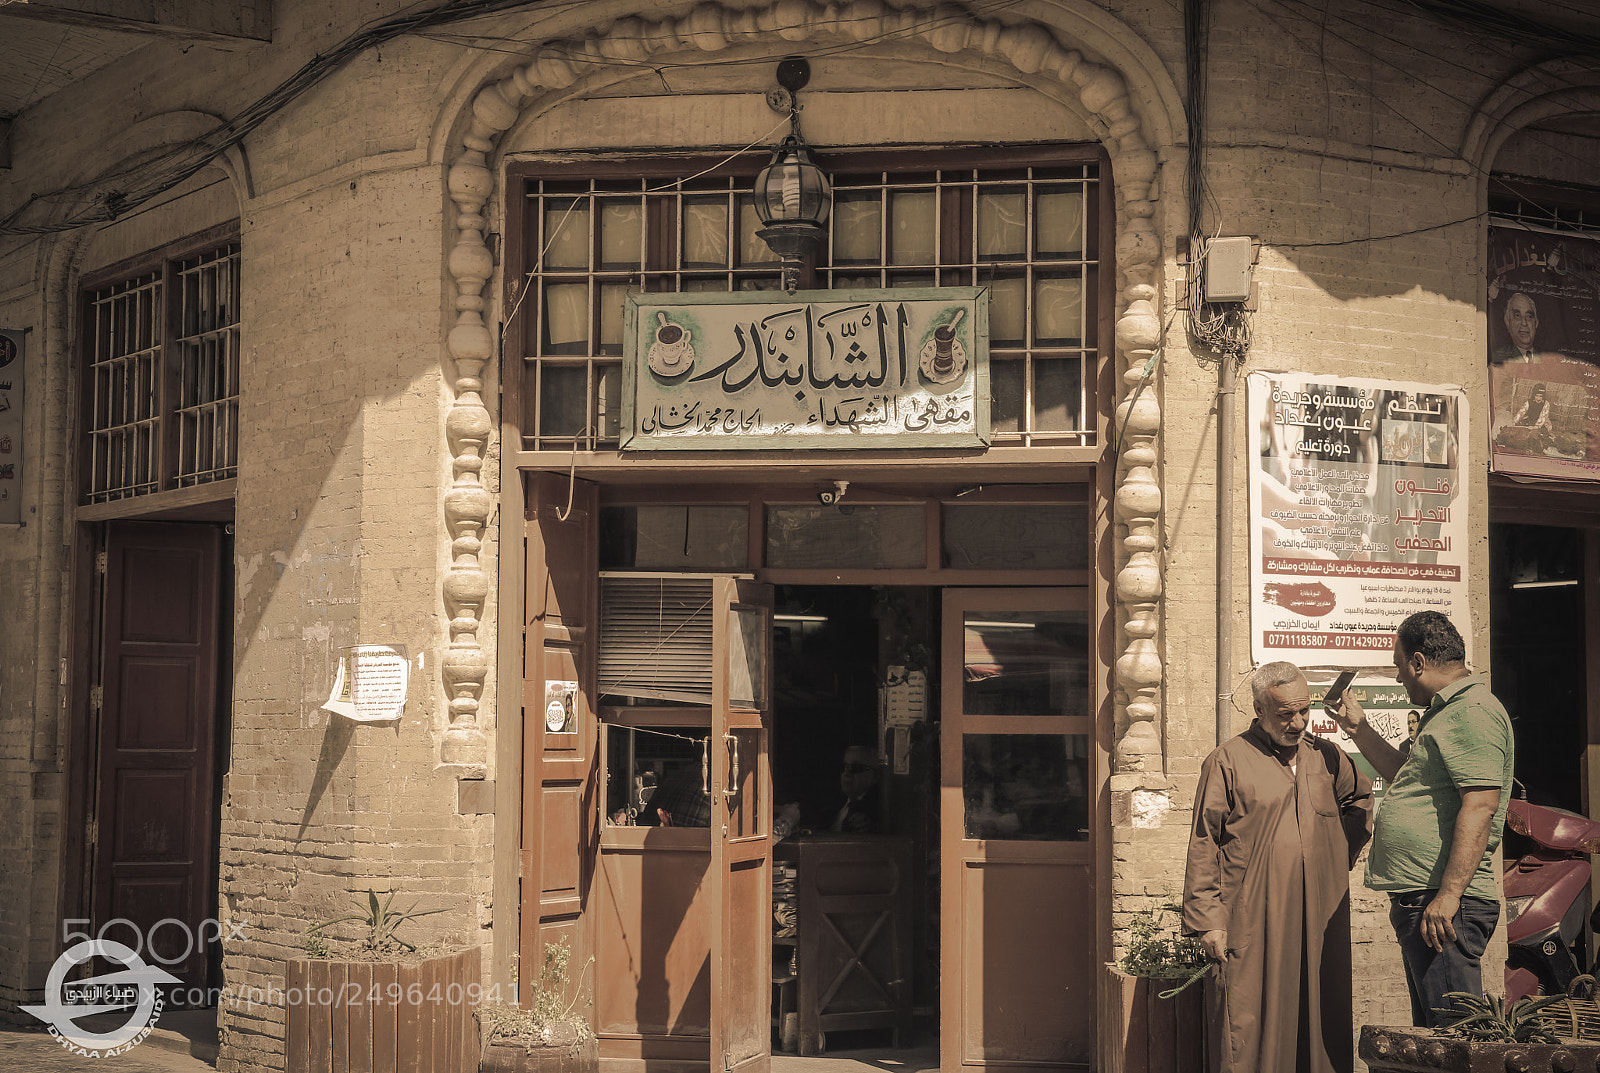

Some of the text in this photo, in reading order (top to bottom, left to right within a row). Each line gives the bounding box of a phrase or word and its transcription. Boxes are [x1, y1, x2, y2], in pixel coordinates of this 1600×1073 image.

[1271, 385, 1442, 416] تنظم مؤسسة وجريدة
[1274, 409, 1372, 434] عيون بغداد
[1295, 437, 1351, 456] دورة تعليم
[1318, 468, 1336, 480] العمل
[1350, 470, 1370, 482] مدخل
[1395, 478, 1450, 496] فنون
[1395, 506, 1451, 527] التحرير
[1395, 534, 1451, 555] الصحفي
[1380, 565, 1408, 575] الصحافة
[1408, 567, 1419, 576] فن
[1420, 568, 1434, 578] في
[1268, 634, 1328, 646] 07711185807
[1335, 636, 1393, 648] 07714290293
